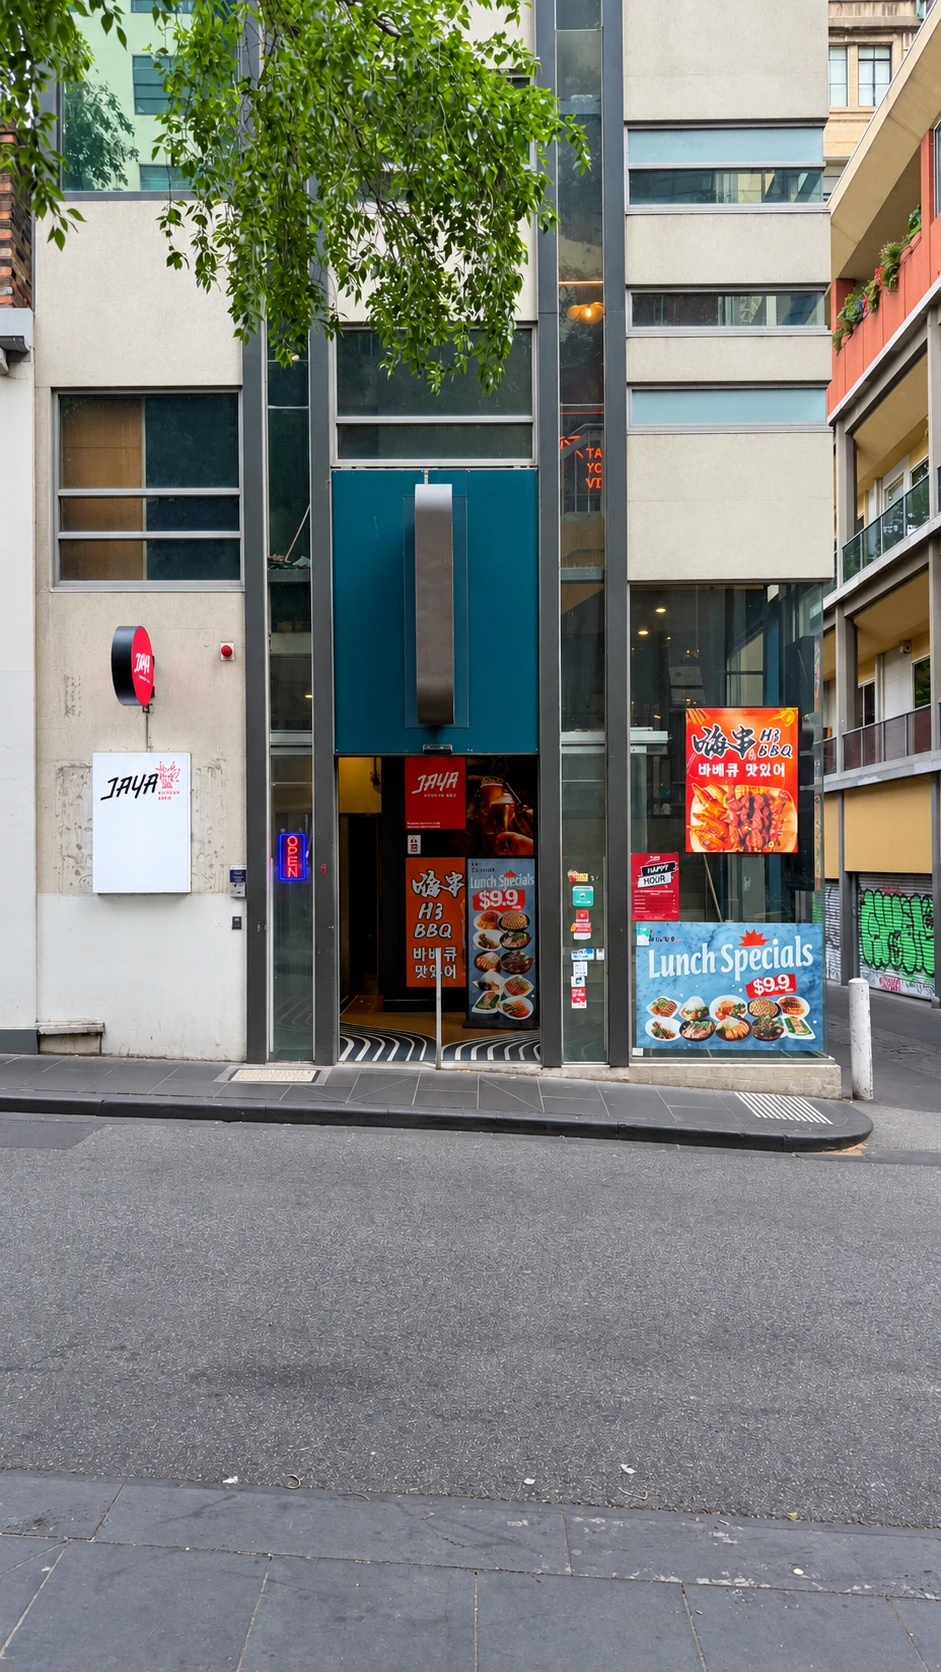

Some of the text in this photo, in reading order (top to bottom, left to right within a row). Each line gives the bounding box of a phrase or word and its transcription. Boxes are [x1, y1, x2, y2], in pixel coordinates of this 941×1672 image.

[758, 743, 793, 760] BBQ
[698, 763, 786, 778] 바베큐 맛있어
[100, 772, 159, 801] JAYA
[411, 771, 460, 795] JAYA
[287, 835, 299, 878] OPEN
[470, 872, 535, 892] Lunch Specials
[643, 874, 666, 886] HOUR
[478, 888, 520, 911] $9.9
[417, 901, 444, 921] H3
[413, 922, 453, 940] BBQ
[648, 935, 814, 982] Lunch Specials
[752, 973, 791, 997] $9.9
